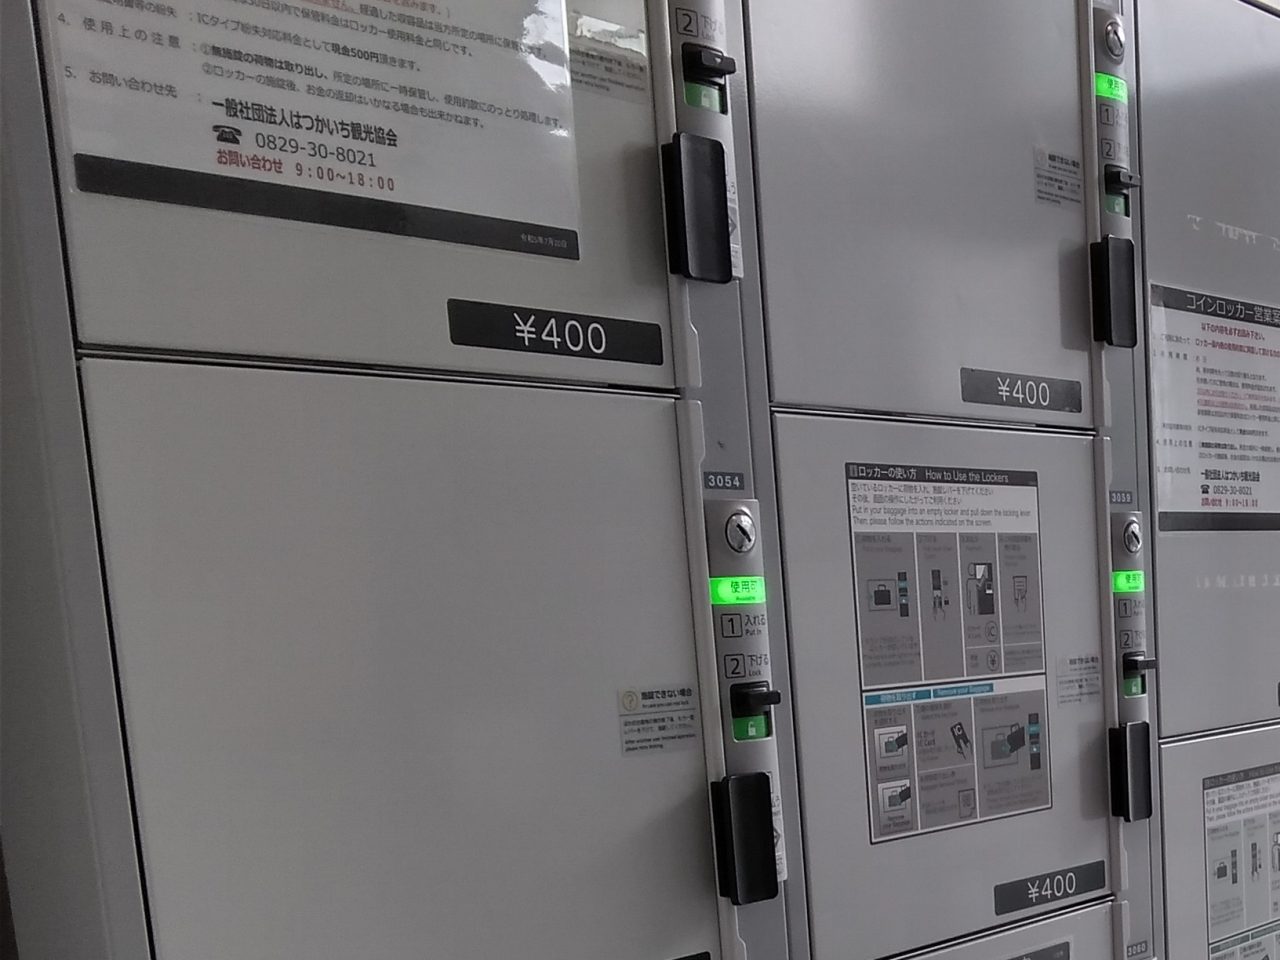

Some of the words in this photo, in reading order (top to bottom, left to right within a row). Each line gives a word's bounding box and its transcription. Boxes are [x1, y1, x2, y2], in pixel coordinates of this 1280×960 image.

[212, 98, 398, 148] 一般社団法人はつかいち観光協会
[216, 149, 283, 174] お問い合わせ
[255, 133, 377, 168] 0829-30-8021
[513, 312, 606, 354] ¥400
[997, 376, 1050, 406] ¥400
[708, 474, 740, 488] 3054
[858, 466, 917, 478] ロッカーの使い方
[925, 469, 941, 479] How
[943, 470, 951, 480] to
[952, 471, 967, 481] Use
[968, 472, 980, 482] the
[981, 472, 1009, 483] Lockers
[1028, 872, 1076, 903] ¥400
